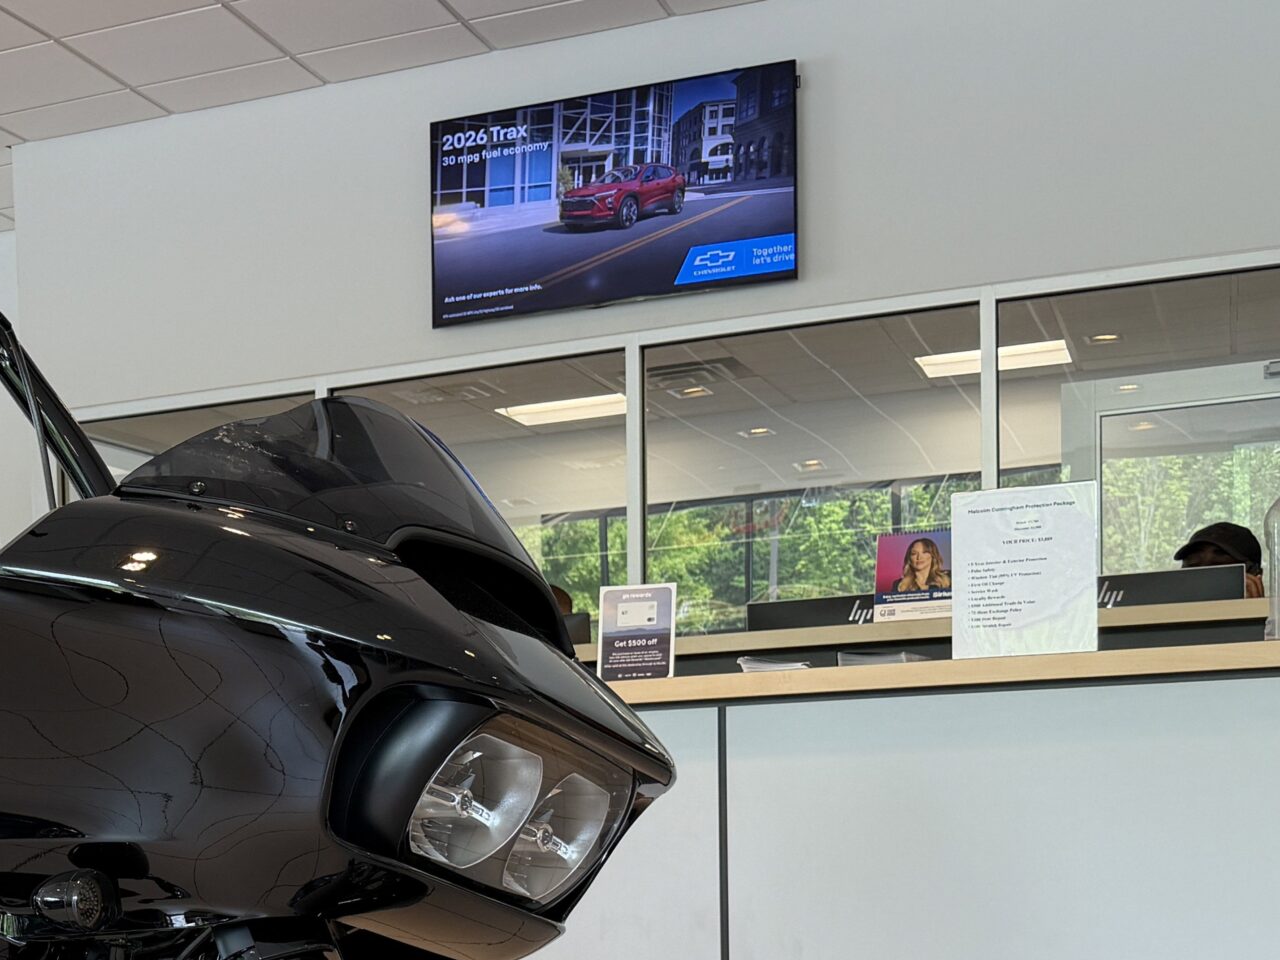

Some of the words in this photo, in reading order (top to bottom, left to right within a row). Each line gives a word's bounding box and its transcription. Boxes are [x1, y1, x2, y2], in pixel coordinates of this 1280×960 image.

[442, 128, 487, 151] 2026
[489, 125, 528, 142] Trax
[442, 155, 455, 166] 30
[457, 153, 480, 164] mpg
[481, 147, 501, 159] fuel
[502, 141, 549, 156] economy
[752, 245, 792, 256] Together
[752, 255, 771, 265] let's
[693, 265, 736, 276] CHEVROLET
[1098, 581, 1124, 608] hp
[848, 600, 873, 624] hp
[614, 640, 626, 648] Get
[627, 639, 646, 647] $500
[647, 638, 658, 646] off
